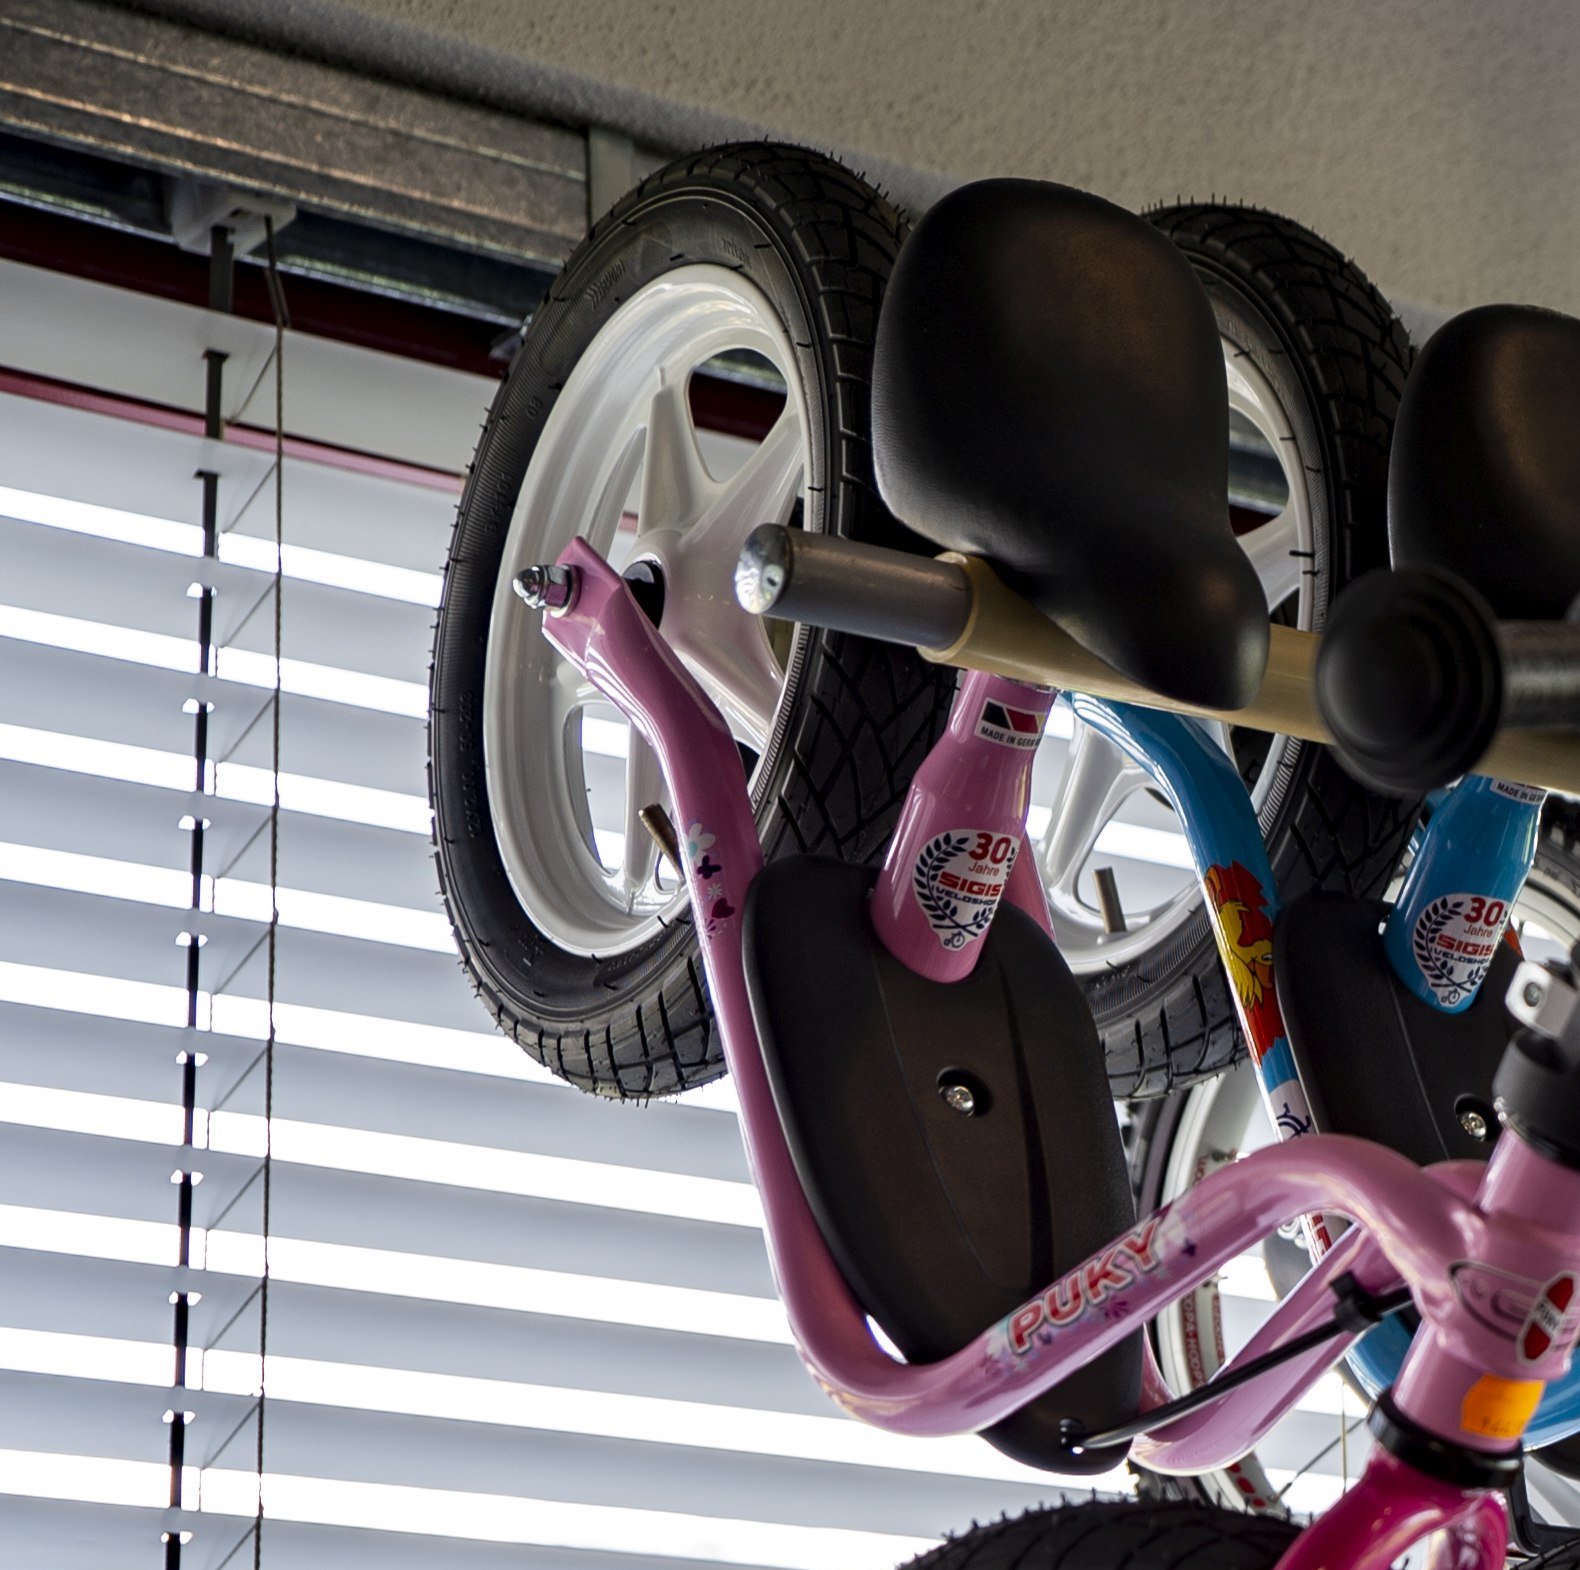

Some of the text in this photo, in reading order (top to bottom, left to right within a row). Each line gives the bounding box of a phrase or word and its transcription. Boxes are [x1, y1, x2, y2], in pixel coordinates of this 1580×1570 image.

[980, 726, 1002, 742] MADE
[1007, 735, 1016, 748] IN
[1497, 783, 1520, 797] MADE
[968, 832, 1012, 864] 30
[968, 862, 1000, 877] Jahre
[938, 872, 1003, 897] SIGIS
[1463, 897, 1504, 926] 30
[1463, 924, 1493, 938] Jahre
[1436, 934, 1495, 956] SIGIS
[1008, 1220, 1158, 1354] PUKY
